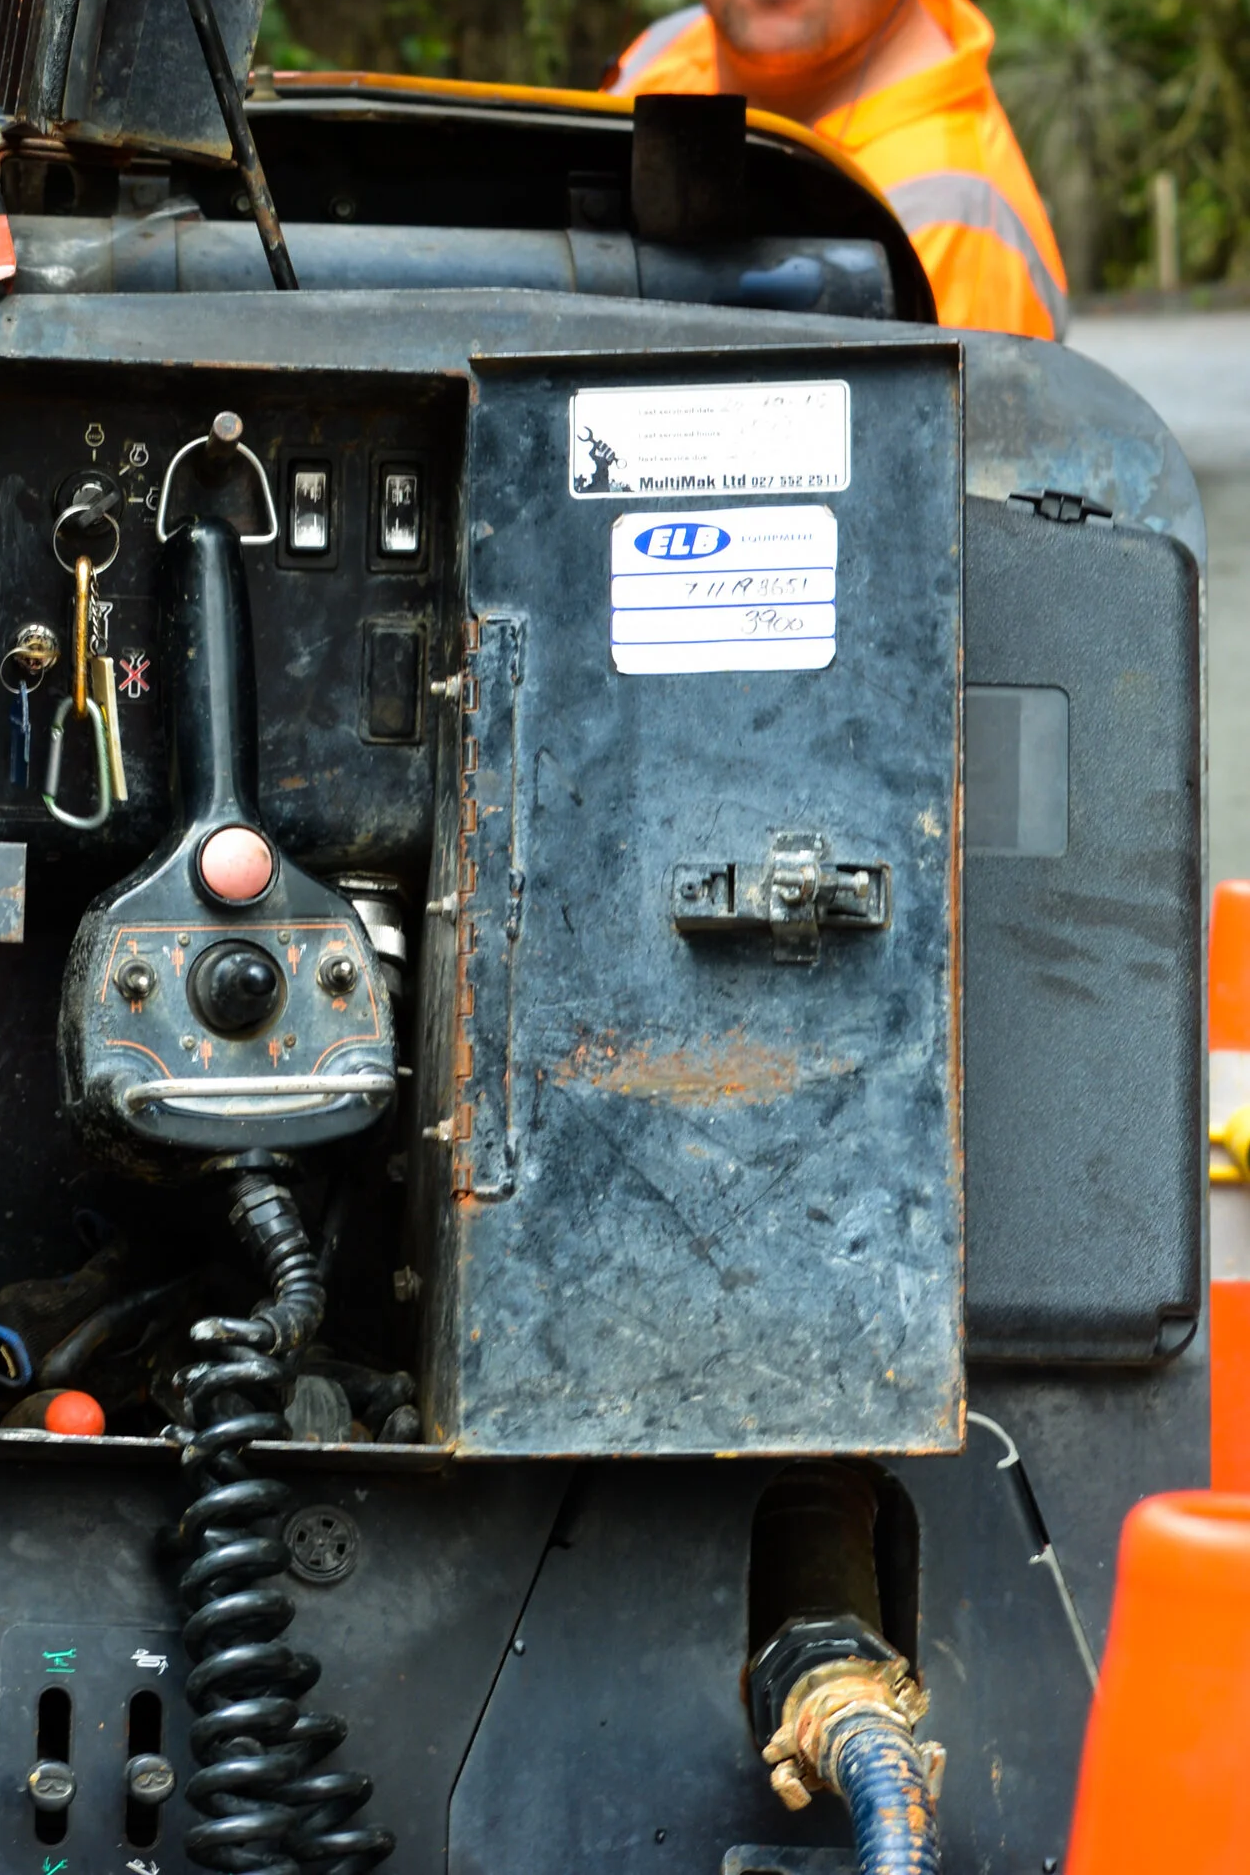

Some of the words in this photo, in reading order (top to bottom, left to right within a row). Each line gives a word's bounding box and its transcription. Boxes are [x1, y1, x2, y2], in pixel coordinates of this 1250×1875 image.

[723, 474, 746, 489] Ltd
[751, 475, 774, 487] 027
[808, 474, 838, 487] 2511
[647, 526, 720, 556] ELB
